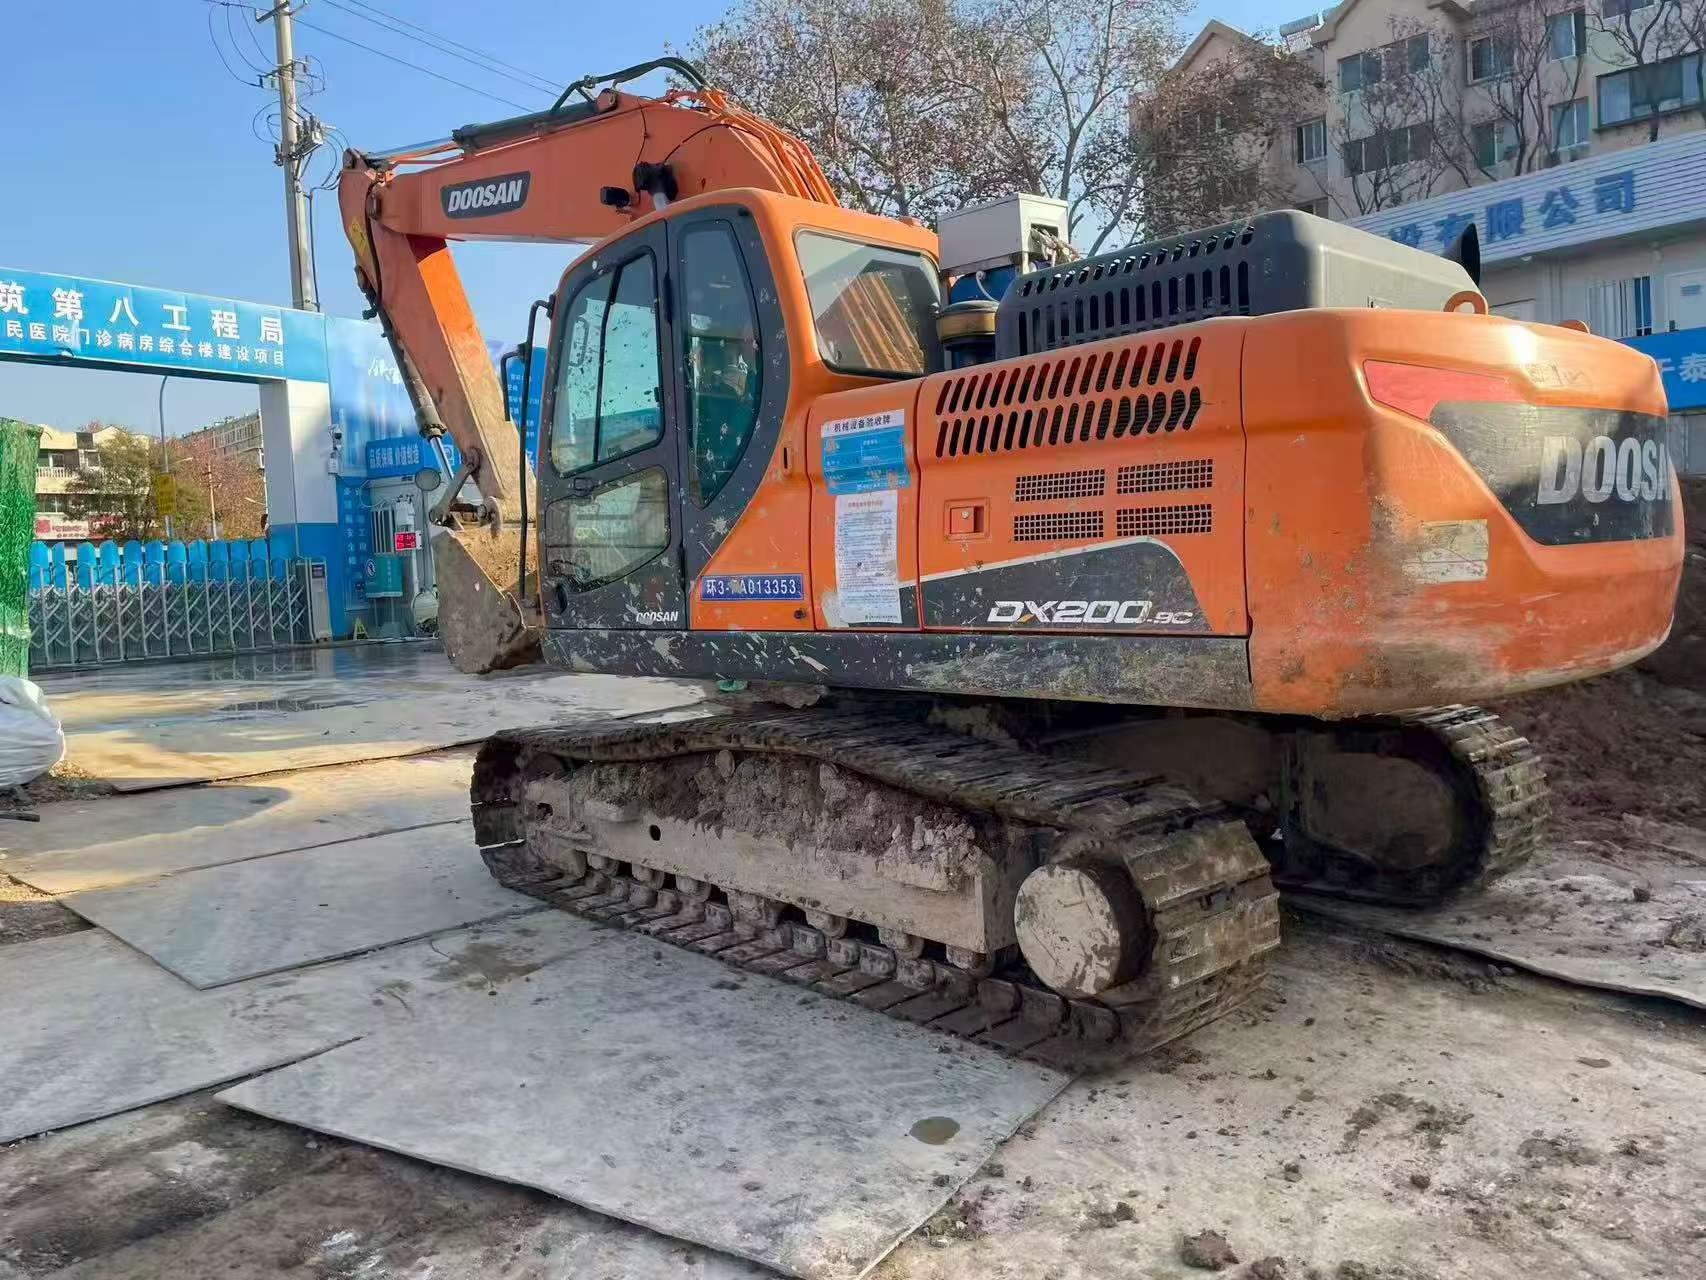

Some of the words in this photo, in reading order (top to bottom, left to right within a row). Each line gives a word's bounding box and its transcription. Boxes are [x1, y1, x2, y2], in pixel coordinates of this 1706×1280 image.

[448, 180, 523, 212] DOOSAN
[0, 280, 284, 345] 筑第八工程局
[6, 319, 285, 366] 民医院门诊病房综合楼建设项目
